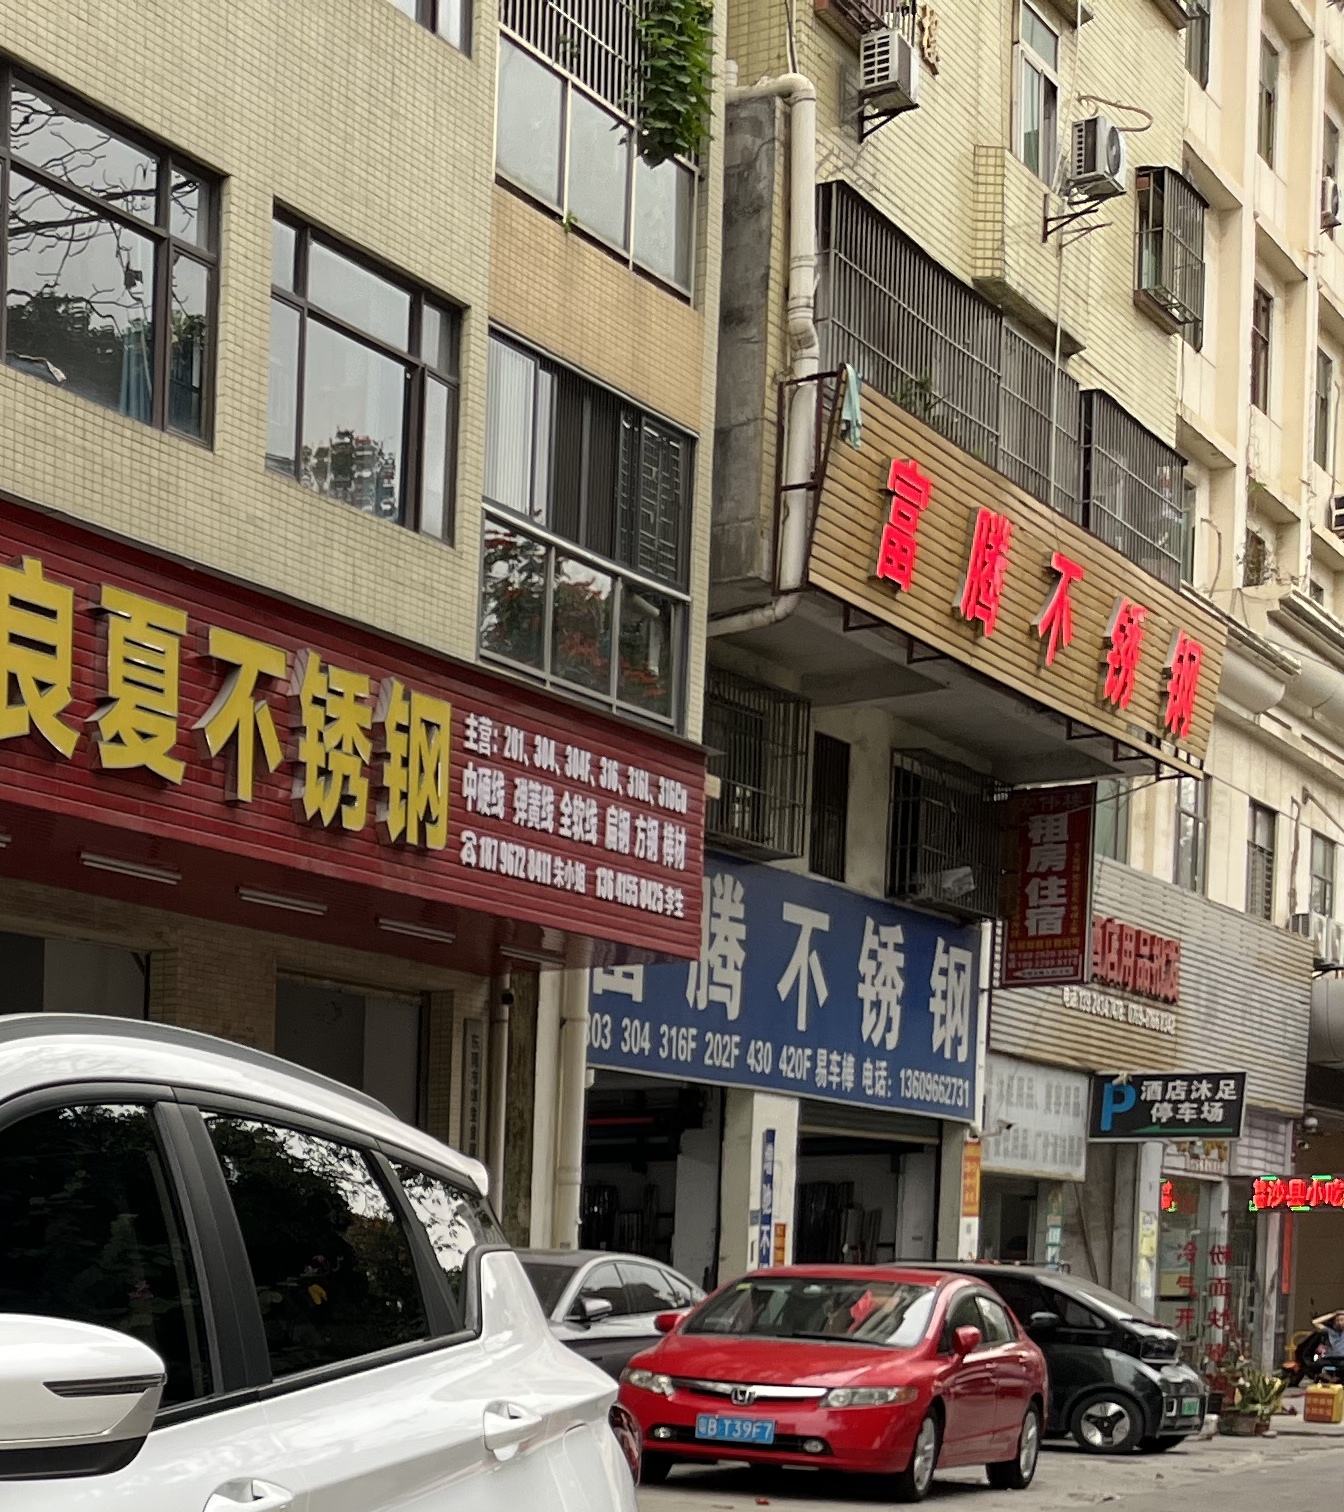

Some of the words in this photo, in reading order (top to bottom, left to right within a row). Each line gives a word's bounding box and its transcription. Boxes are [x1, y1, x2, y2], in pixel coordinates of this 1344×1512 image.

[621, 1017, 650, 1056] 304
[659, 1024, 697, 1062] 316F
[704, 1031, 741, 1069] 202F
[747, 1039, 772, 1074] 430
[779, 1045, 811, 1081] 420F
[1100, 1082, 1136, 1132] P
[1140, 1080, 1237, 1101] 酒店沐足
[1150, 1103, 1224, 1123] 停车场
